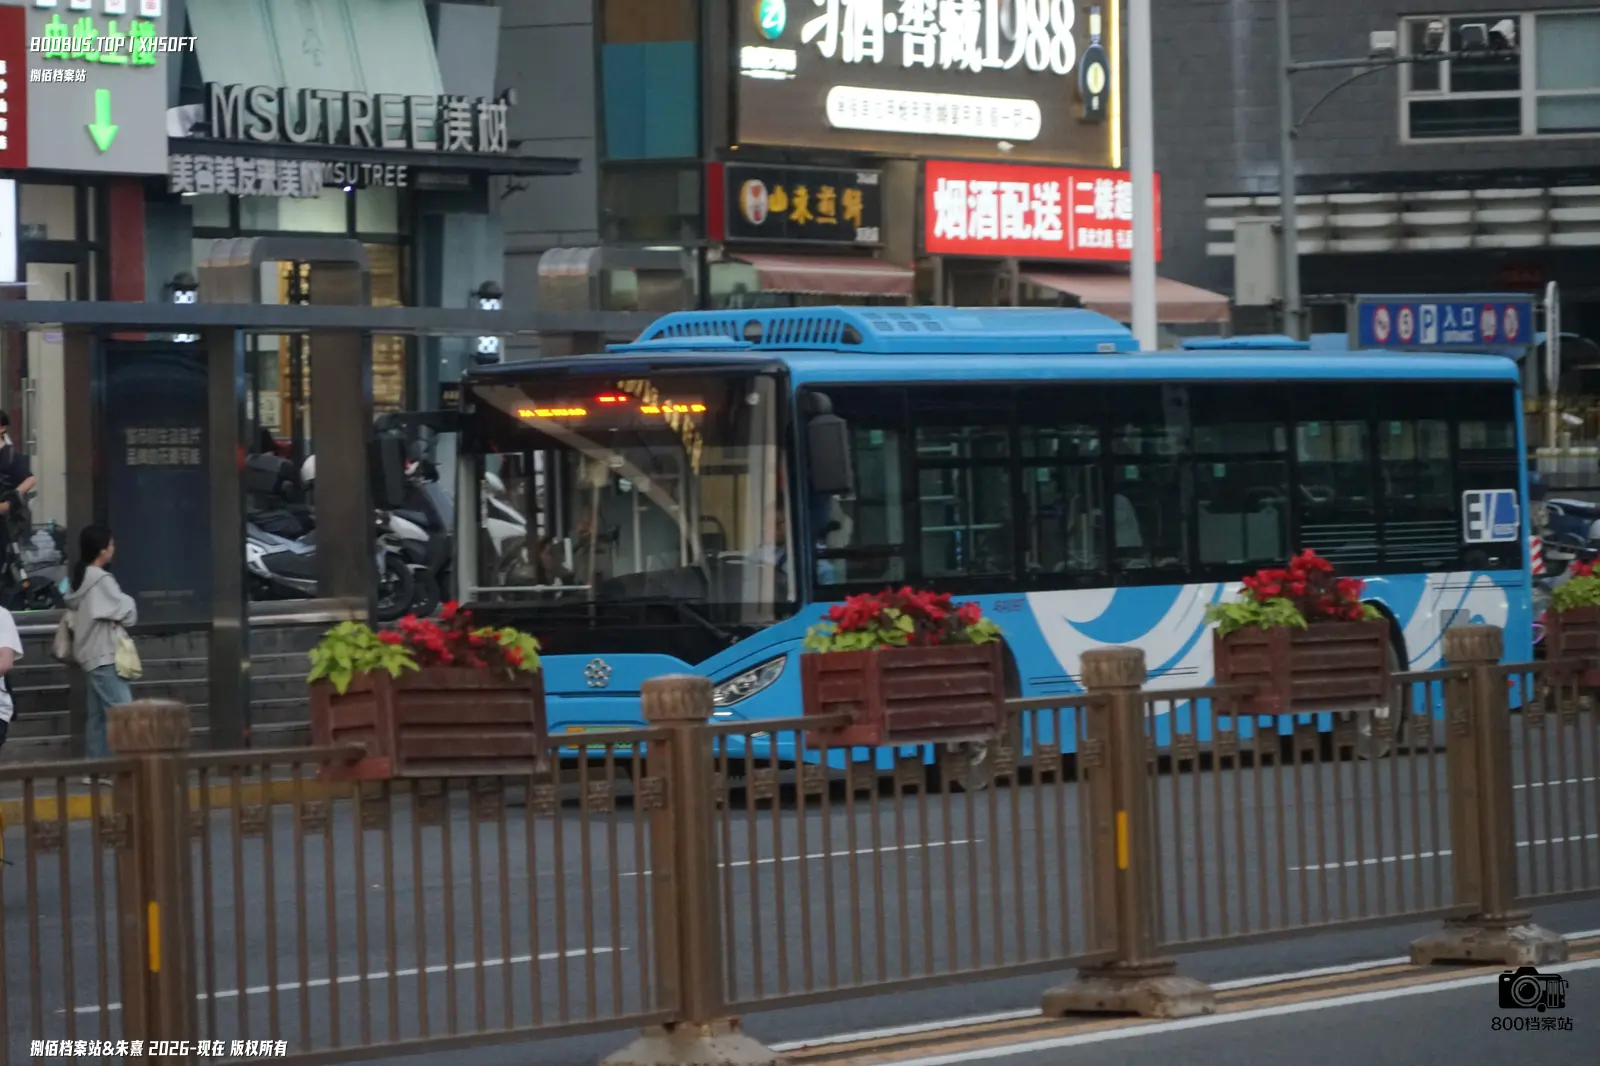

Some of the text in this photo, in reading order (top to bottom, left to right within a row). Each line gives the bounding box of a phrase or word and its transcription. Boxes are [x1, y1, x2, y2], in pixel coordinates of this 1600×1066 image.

[933, 178, 1063, 240] 烟酒配送
[1443, 305, 1475, 328] 入口
